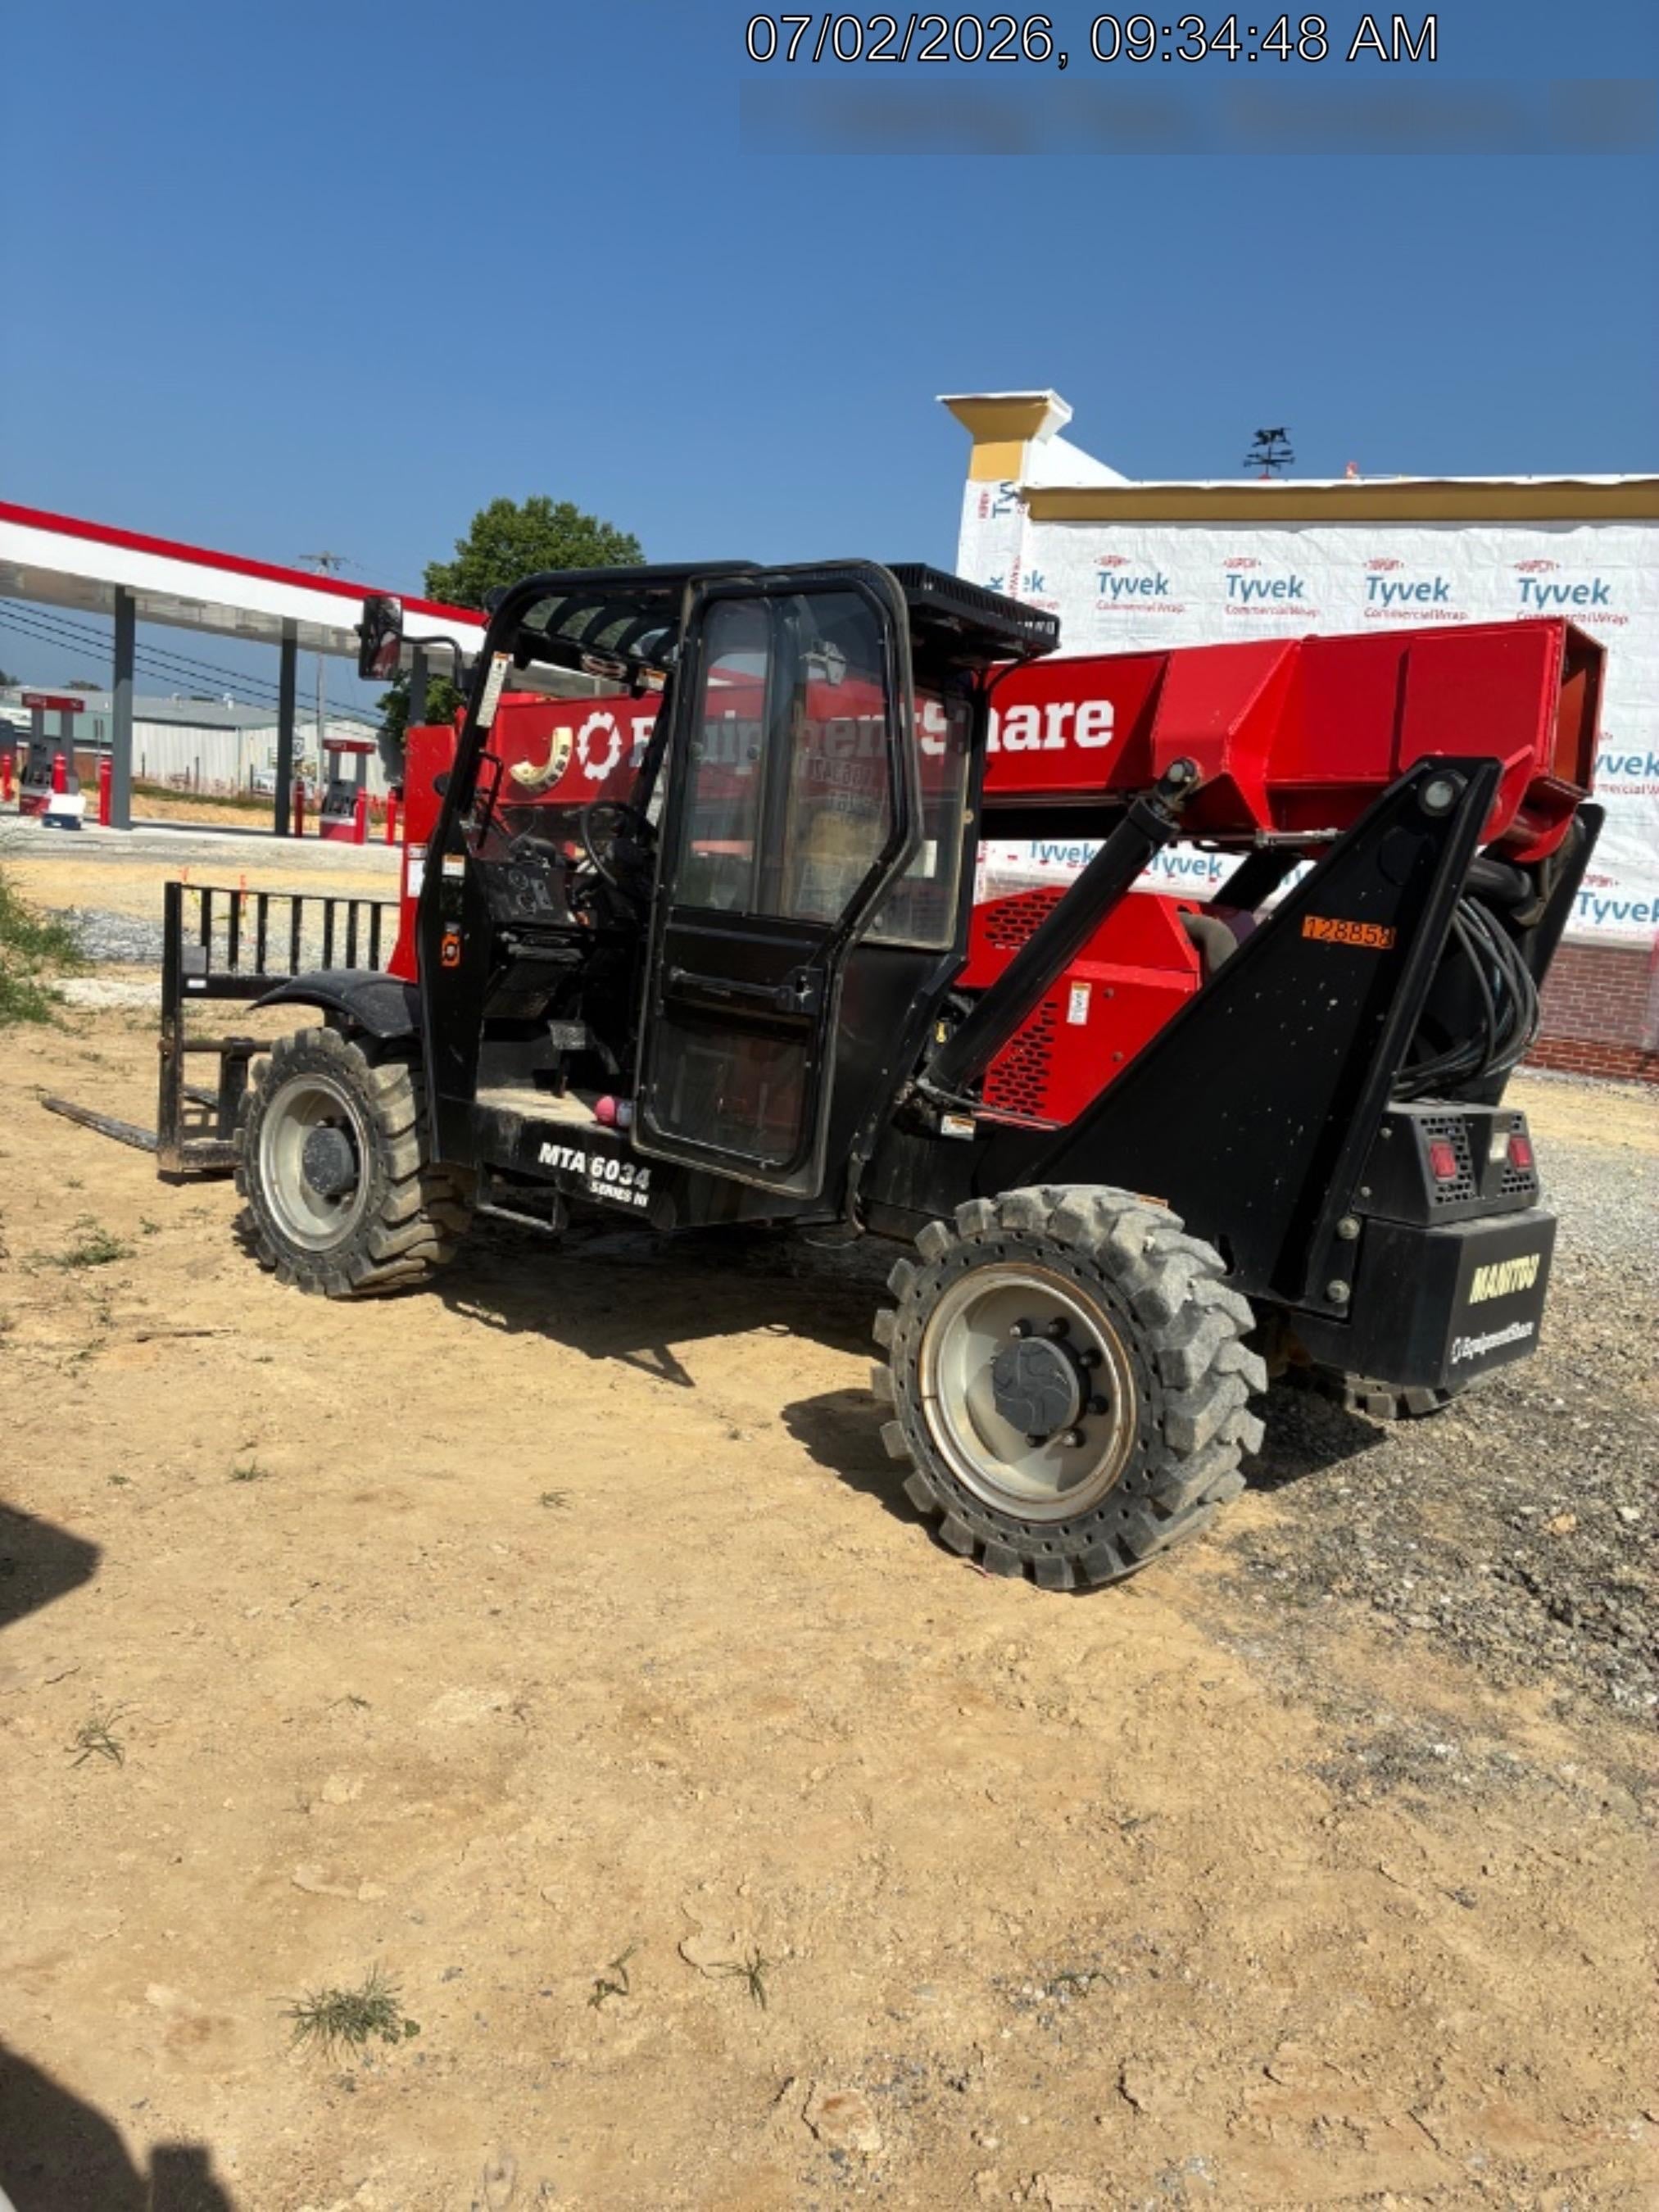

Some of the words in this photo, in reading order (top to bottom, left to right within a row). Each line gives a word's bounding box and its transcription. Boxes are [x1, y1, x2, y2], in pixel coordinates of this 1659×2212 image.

[1096, 571, 1170, 601] Tyvek
[1226, 574, 1304, 604] Tyvek
[1366, 576, 1451, 608] Tyvek
[1517, 577, 1611, 610] Tyvek
[1306, 918, 1393, 947] 128858
[538, 1142, 587, 1173] MTA
[591, 1156, 652, 1190] 6034
